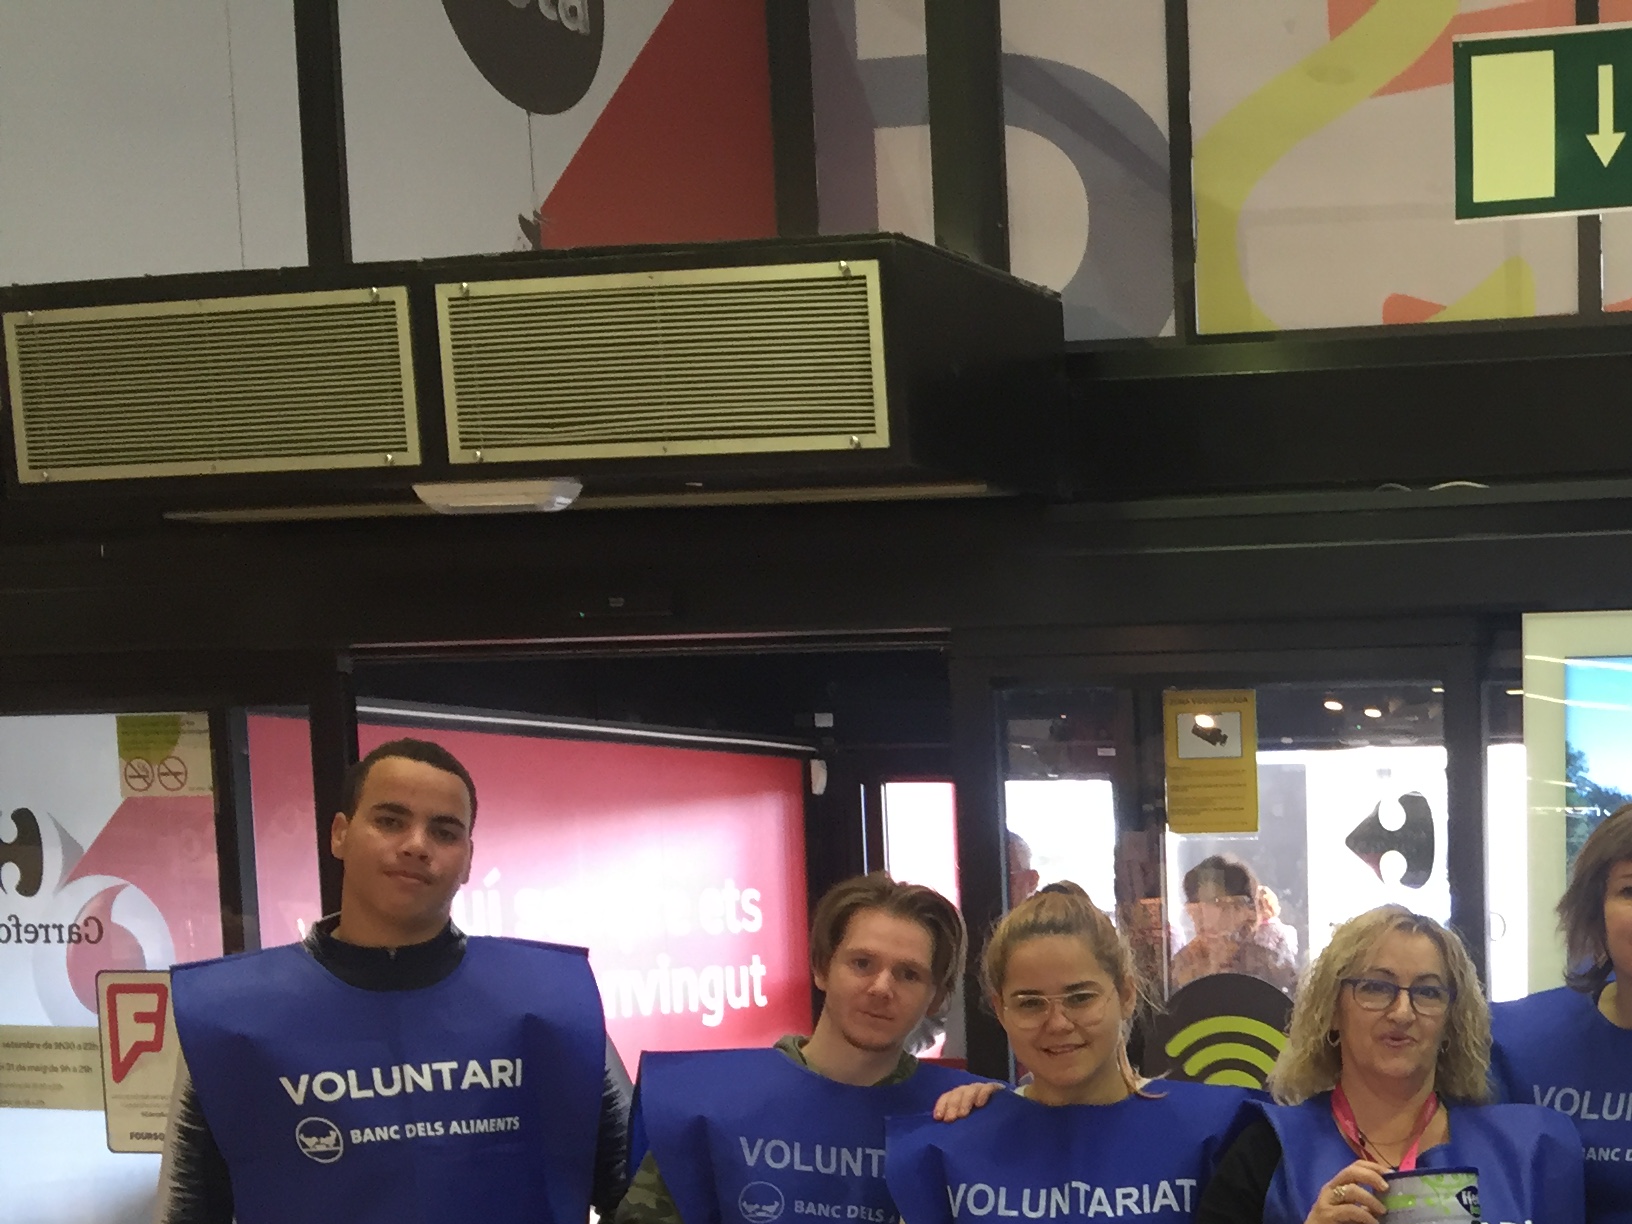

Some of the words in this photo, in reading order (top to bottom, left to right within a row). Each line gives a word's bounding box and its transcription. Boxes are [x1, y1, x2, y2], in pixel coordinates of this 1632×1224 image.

[698, 877, 763, 935] ets
[600, 952, 768, 1027] nvingut
[279, 1058, 523, 1106] VOLUNTARI
[350, 1126, 400, 1144] BANC
[405, 1121, 445, 1139] DELS
[449, 1116, 520, 1135] ALIMENTS
[739, 1136, 887, 1178] VOLUNT
[1584, 1147, 1621, 1161] ANC
[795, 1200, 841, 1219] BANC
[847, 1205, 885, 1224] DELS
[947, 1178, 1197, 1218] VOLUNTARIAT
